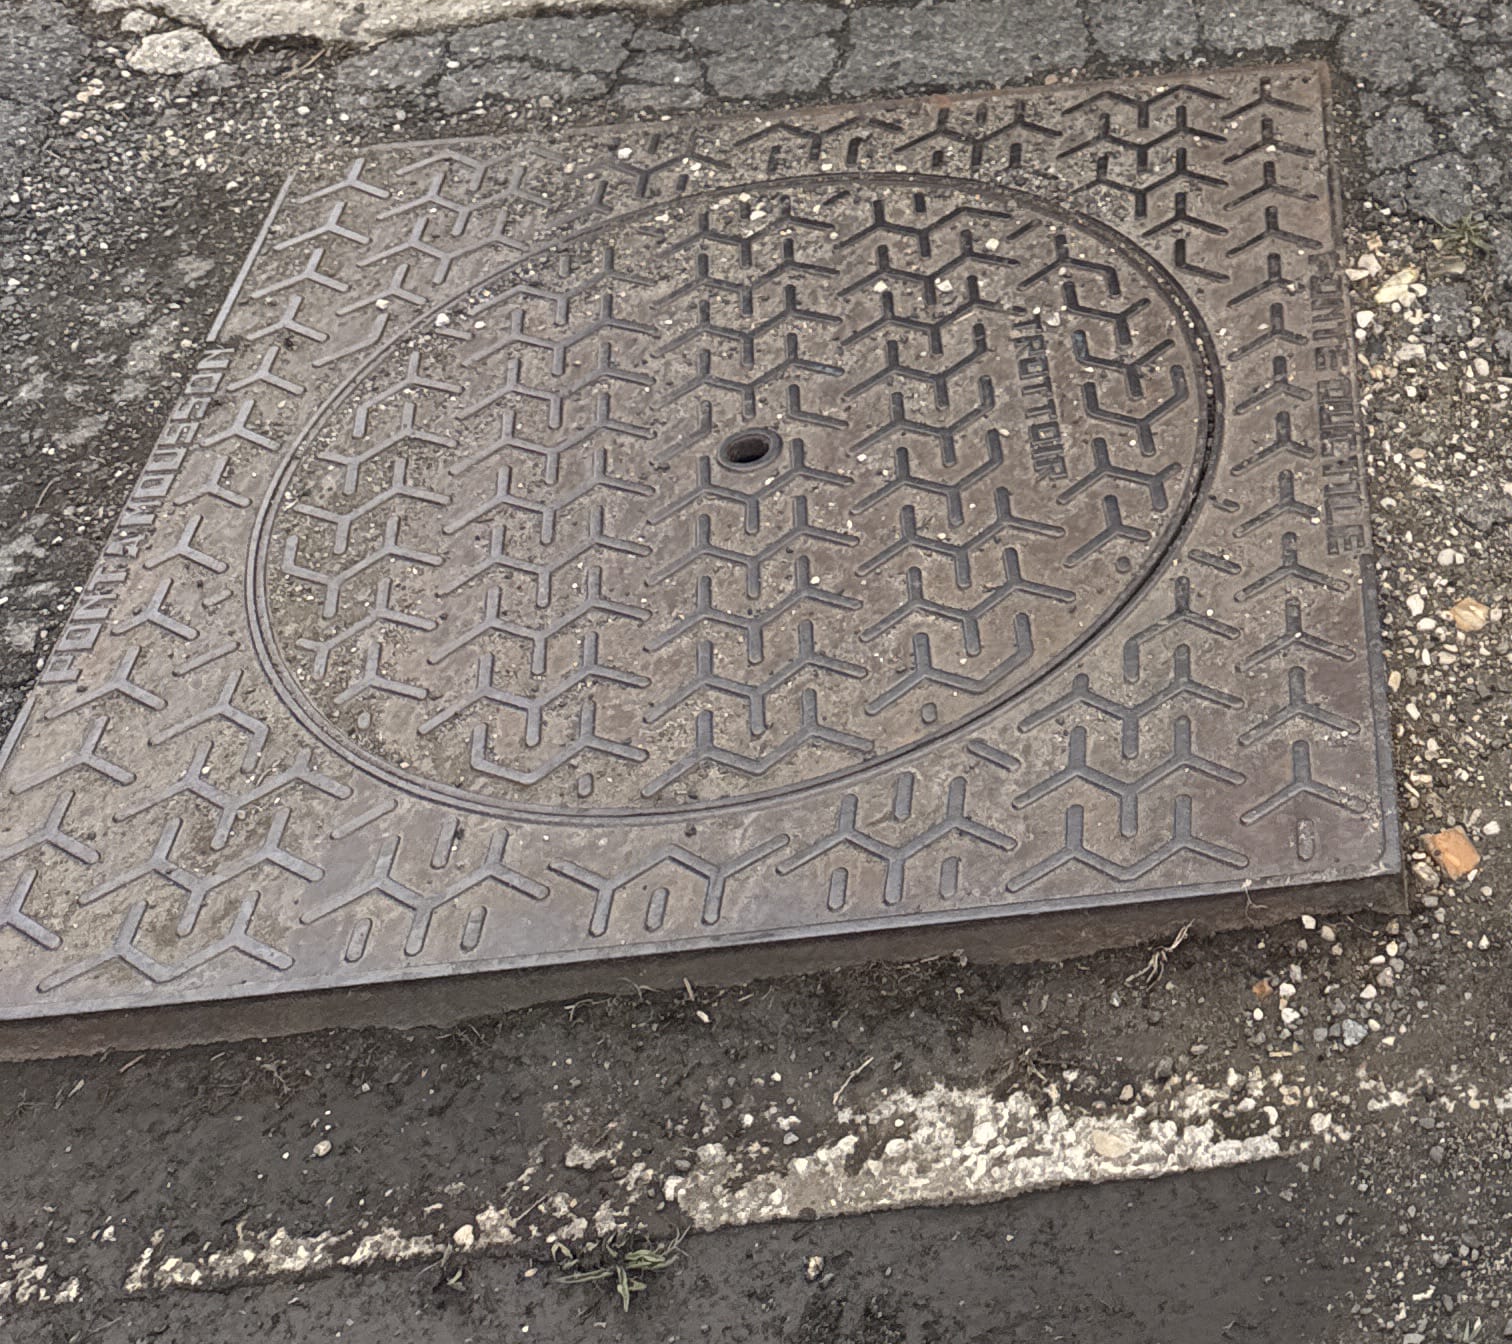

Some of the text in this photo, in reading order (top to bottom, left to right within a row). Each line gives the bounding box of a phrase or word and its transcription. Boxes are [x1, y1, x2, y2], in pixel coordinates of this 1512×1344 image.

[38, 564, 129, 684] PONT
[119, 348, 235, 527] MOUSSON
[1010, 315, 1068, 481] TROTTOIR
